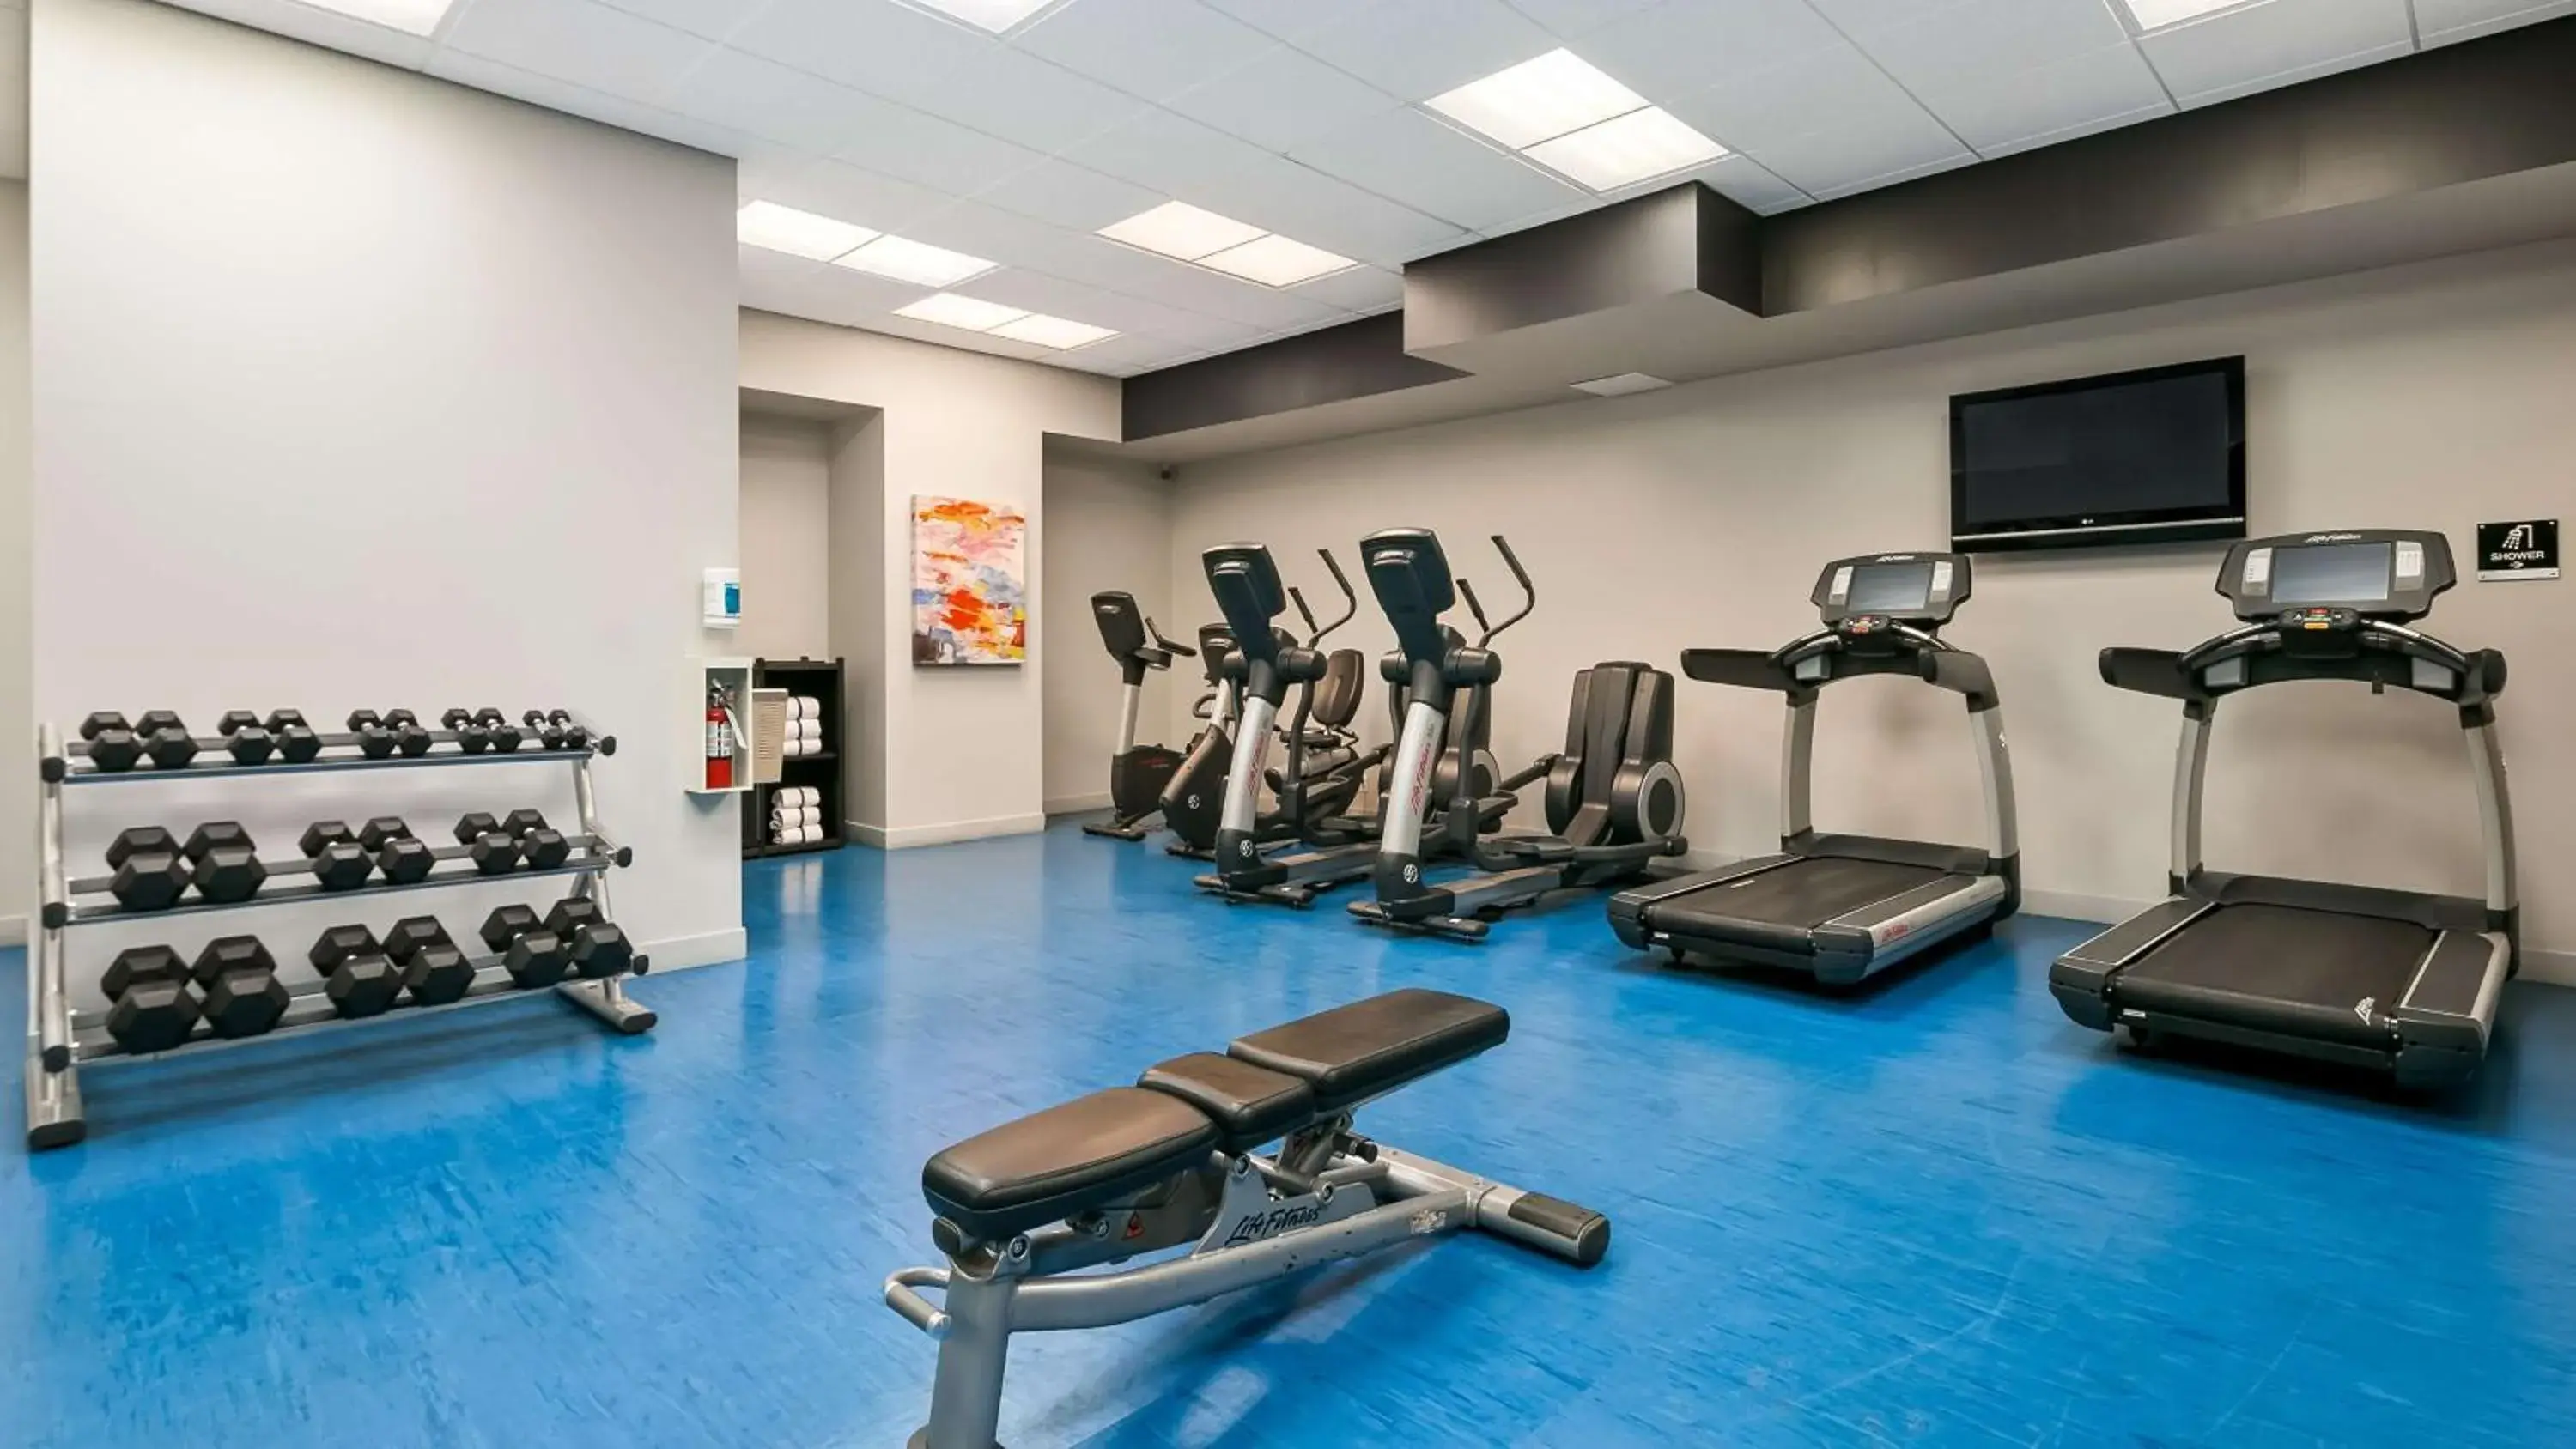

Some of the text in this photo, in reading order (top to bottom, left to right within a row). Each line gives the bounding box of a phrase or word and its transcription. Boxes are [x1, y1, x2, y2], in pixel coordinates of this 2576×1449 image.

[2490, 550, 2544, 561] SHOWER
[1224, 1206, 1319, 1246] Life Fitness
